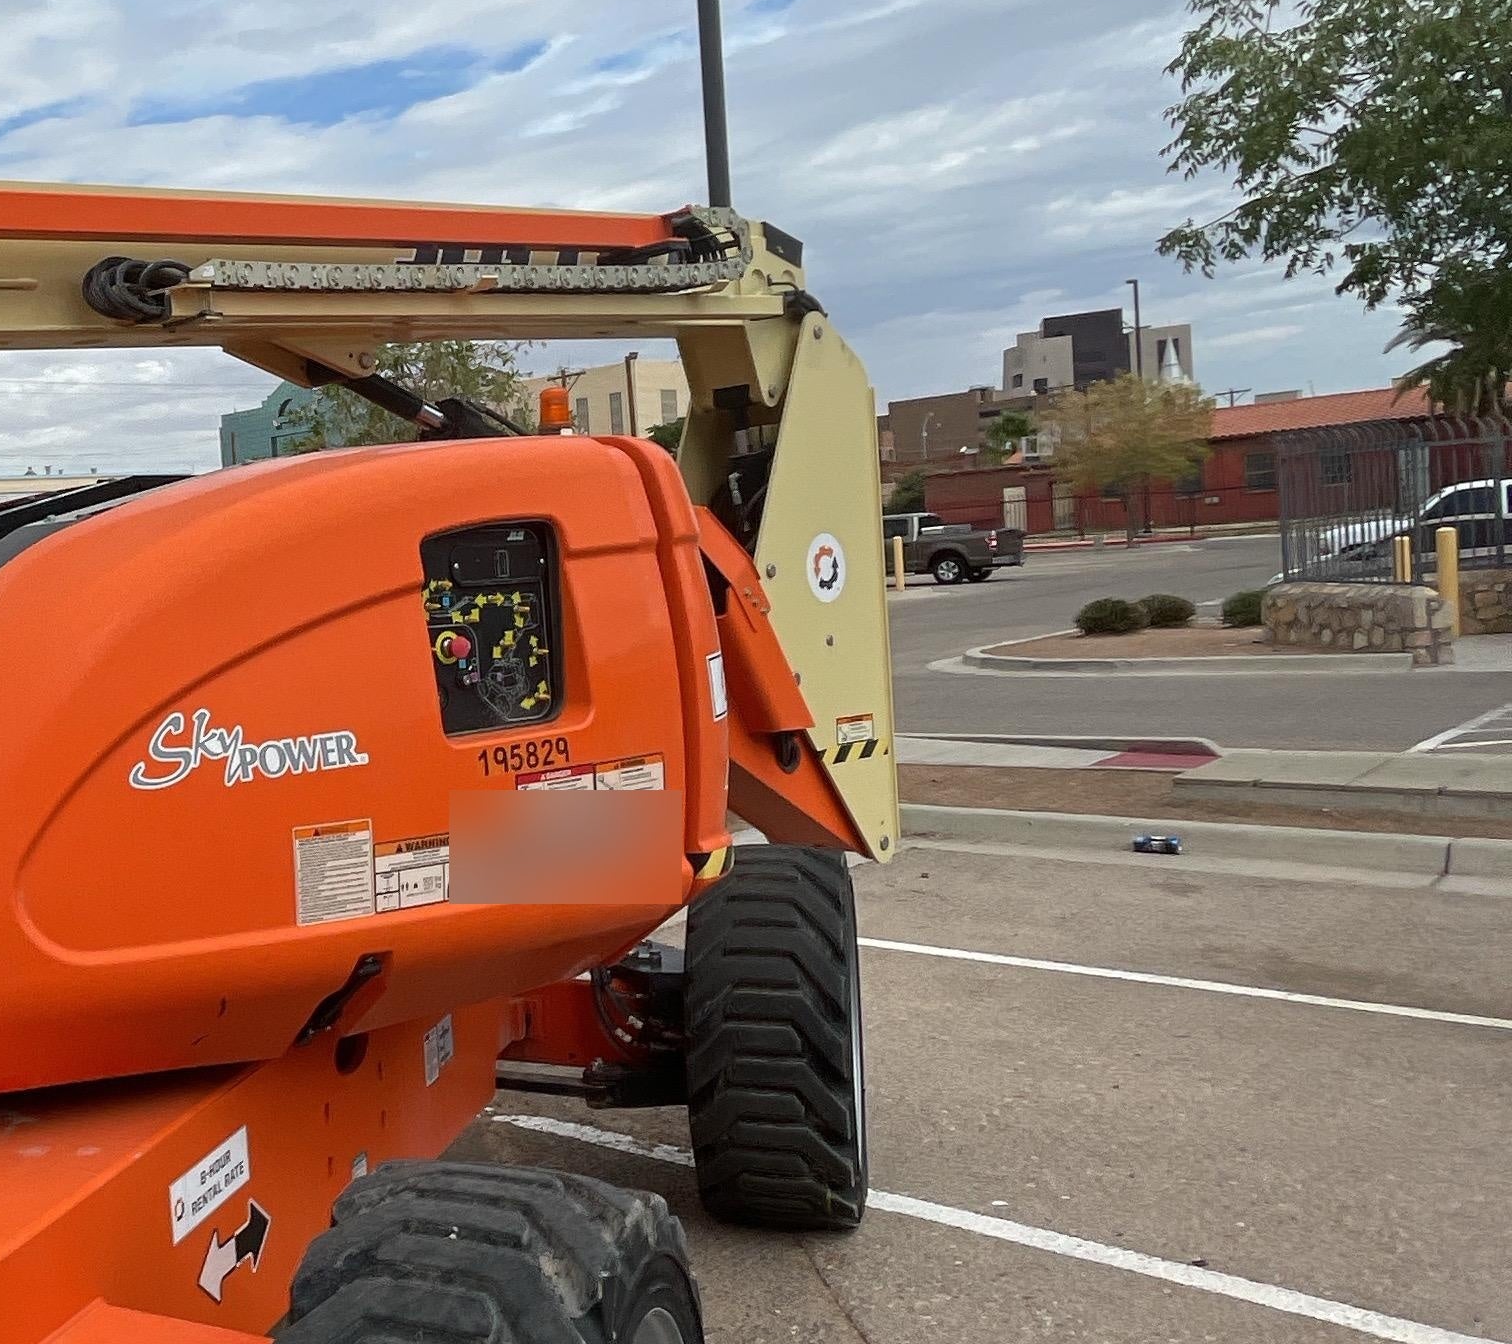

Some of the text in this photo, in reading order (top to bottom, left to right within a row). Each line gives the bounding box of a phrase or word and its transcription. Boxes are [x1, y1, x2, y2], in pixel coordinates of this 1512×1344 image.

[477, 736, 570, 777] 195829
[191, 1160, 244, 1216] RENTAL RATE
